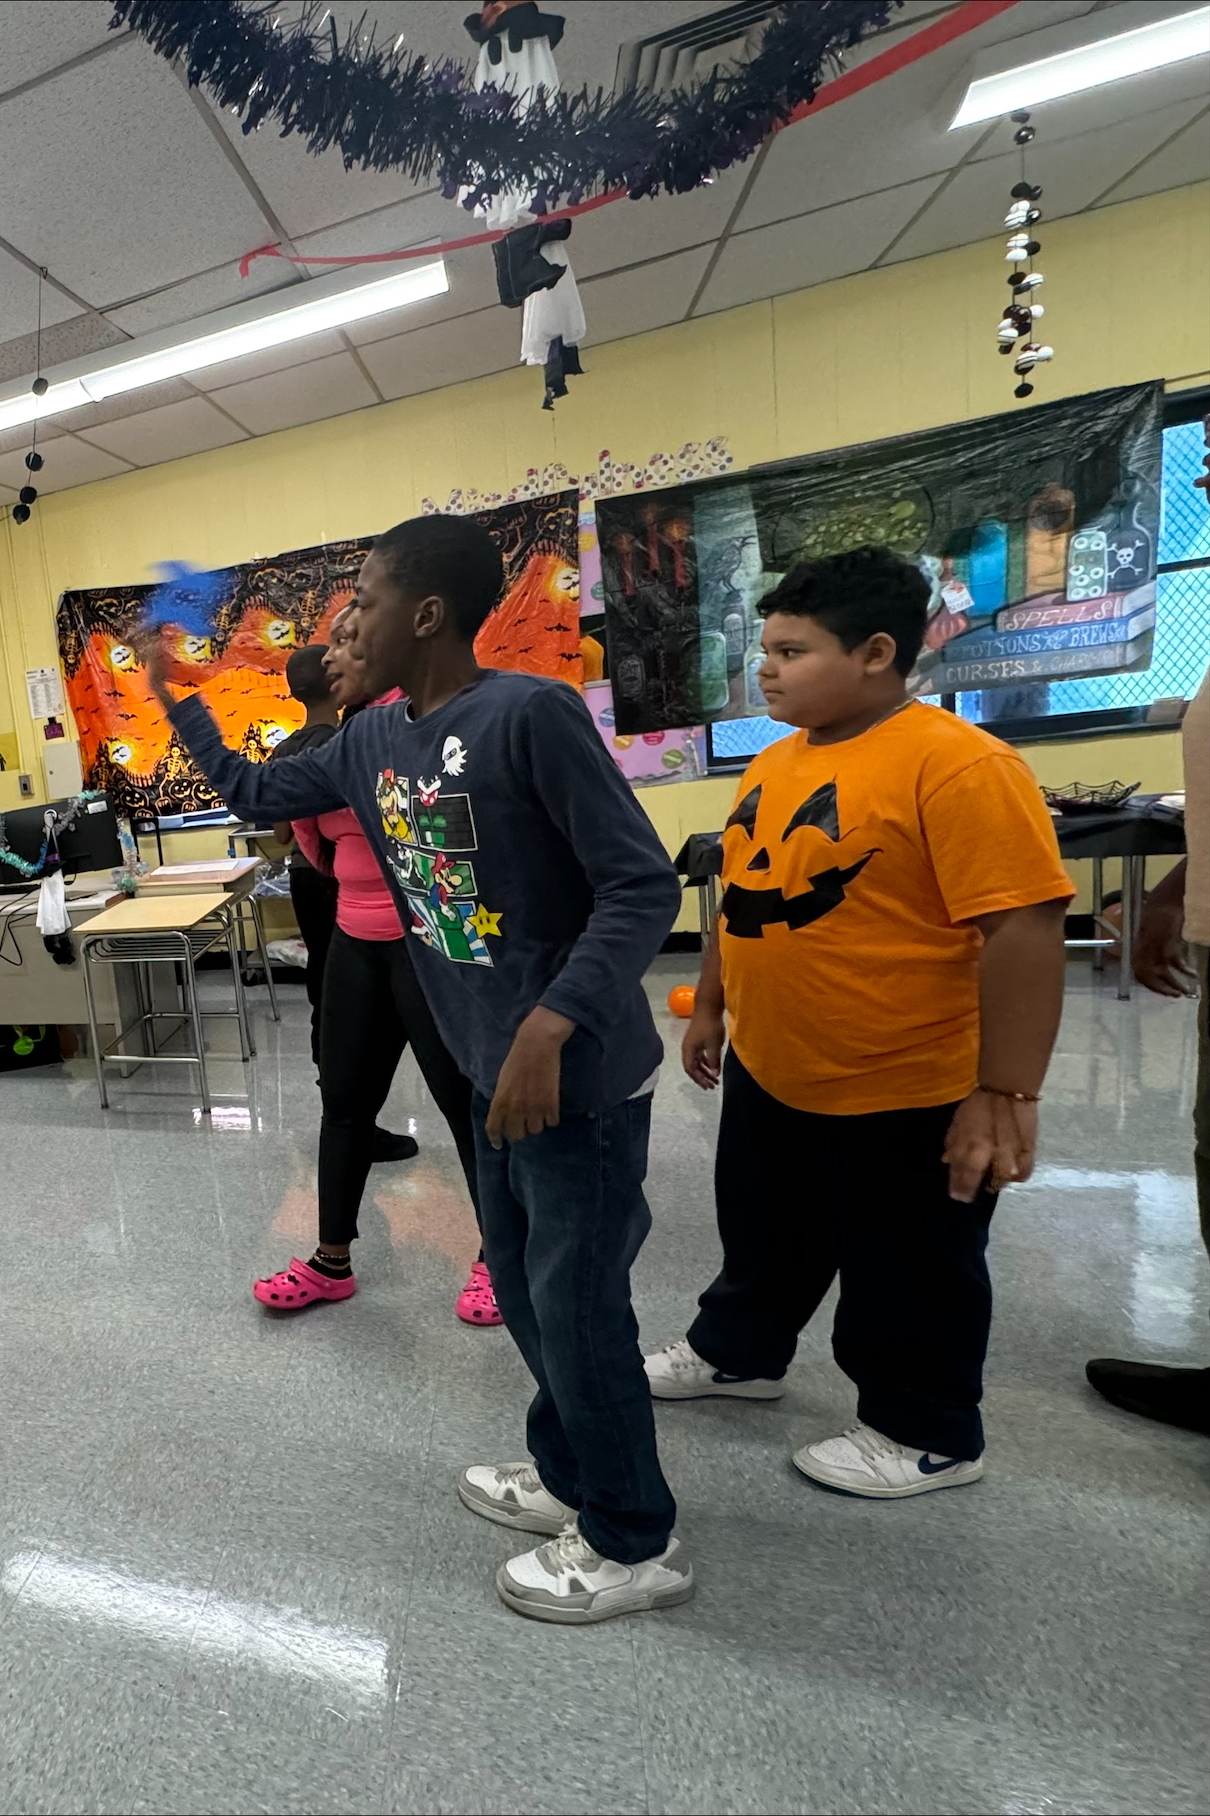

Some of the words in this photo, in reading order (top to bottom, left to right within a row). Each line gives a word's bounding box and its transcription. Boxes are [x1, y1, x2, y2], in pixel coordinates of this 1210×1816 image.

[1005, 600, 1114, 631] SPELLS
[956, 633, 1041, 658] OTIONS
[946, 659, 1026, 684] CURSES
